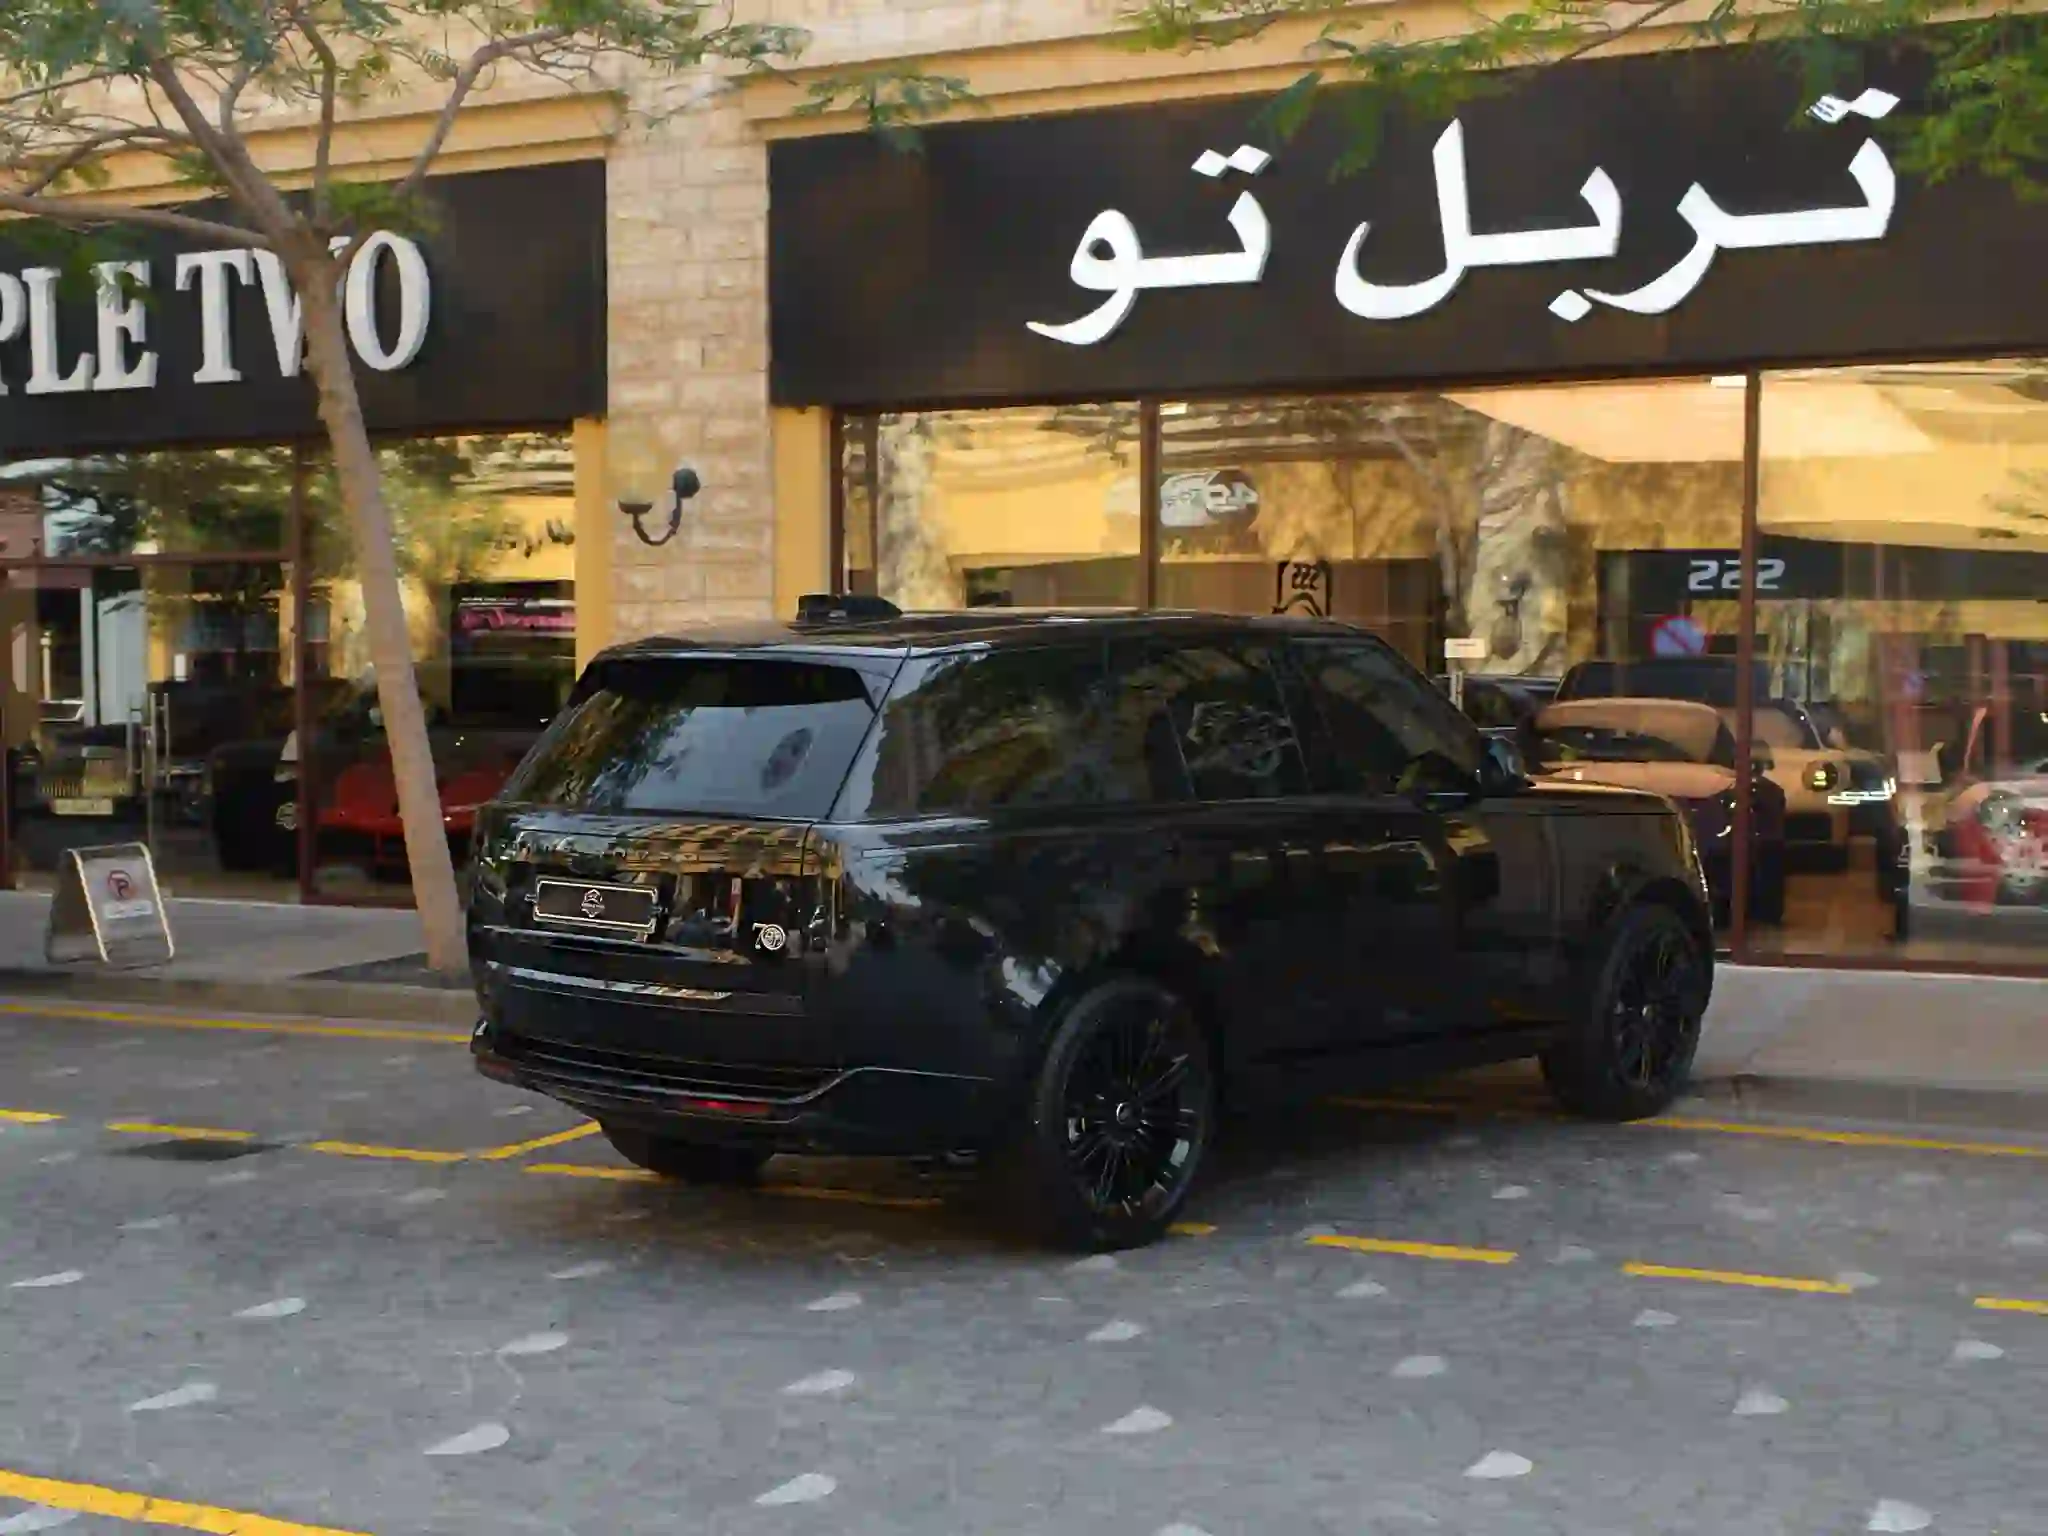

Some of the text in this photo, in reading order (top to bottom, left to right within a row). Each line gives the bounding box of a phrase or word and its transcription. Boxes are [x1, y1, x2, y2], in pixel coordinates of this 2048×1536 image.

[1025, 87, 1901, 346] تربل تو
[1687, 558, 1786, 591] 222
